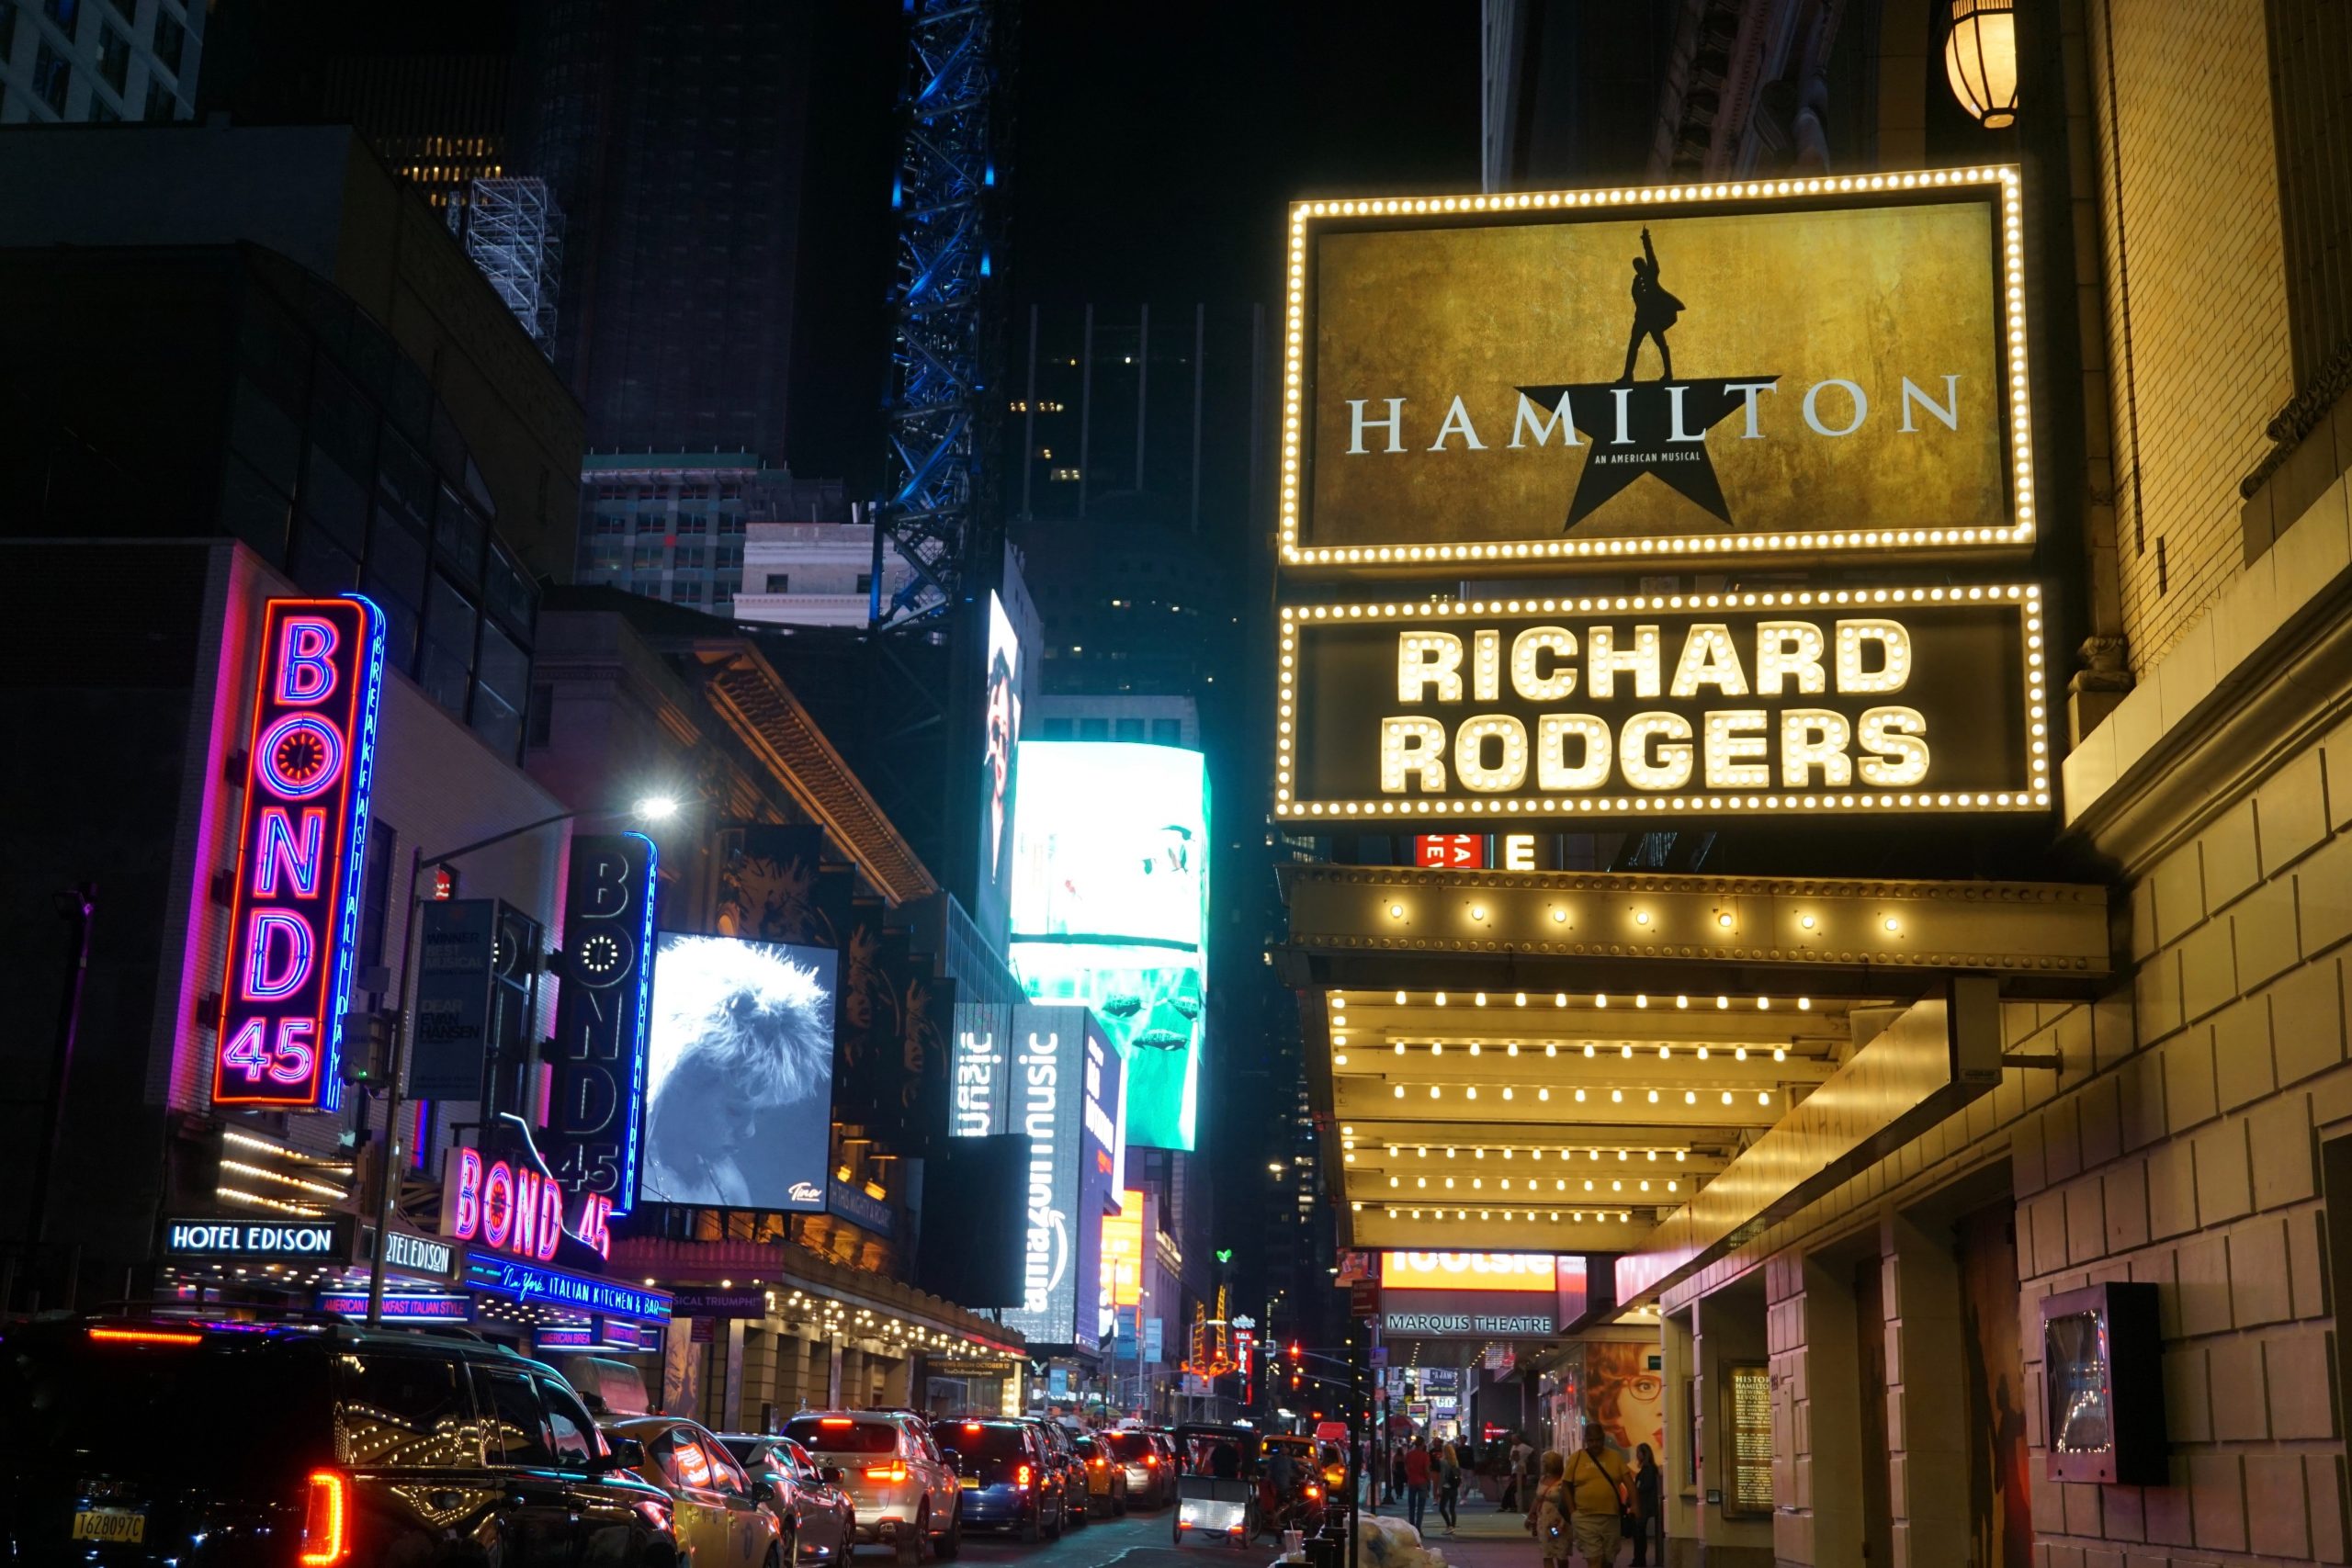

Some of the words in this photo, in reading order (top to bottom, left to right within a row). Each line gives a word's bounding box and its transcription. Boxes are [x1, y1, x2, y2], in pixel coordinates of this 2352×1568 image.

[1344, 373, 1962, 455] HAMILTON
[1594, 455, 1607, 465] AN
[1611, 452, 1657, 464] AMERICAN
[1661, 451, 1701, 462] MUSICAL
[1397, 618, 1913, 704] RICHARD
[353, 635, 382, 871] BREAKFAST
[1380, 705, 1930, 793] RODGERS
[242, 617, 345, 1000] BOND
[343, 896, 356, 971] ALL
[421, 998, 463, 1013] DEAR
[563, 852, 634, 1134] BOND
[223, 1016, 316, 1084] 45
[333, 996, 346, 1073] DAY
[418, 1024, 480, 1039] HANSEN
[1019, 1032, 1057, 1154] music
[554, 1144, 619, 1193] 45
[787, 1181, 822, 1201] Tina
[455, 1145, 563, 1262] BOND
[578, 1191, 614, 1262] 45
[172, 1225, 241, 1250] HOTEL
[247, 1227, 332, 1252] EDISON
[385, 1234, 407, 1264] OTEL
[411, 1237, 449, 1274] EDISON
[1023, 1161, 1053, 1314] amazon
[323, 1298, 364, 1313] AMERICAN
[412, 1300, 439, 1314] ITALIAN
[439, 1301, 465, 1315] STYLE
[519, 1272, 546, 1302] York
[548, 1277, 590, 1302] ITALIAN
[593, 1289, 633, 1311] KITCHEN
[635, 1296, 641, 1314] &
[644, 1297, 660, 1315] BAR
[540, 1332, 572, 1344] AMERICAN
[1388, 1314, 1470, 1334] MARQUIS
[1474, 1316, 1552, 1332] THEATRE
[78, 1514, 141, 1537] T628097C
